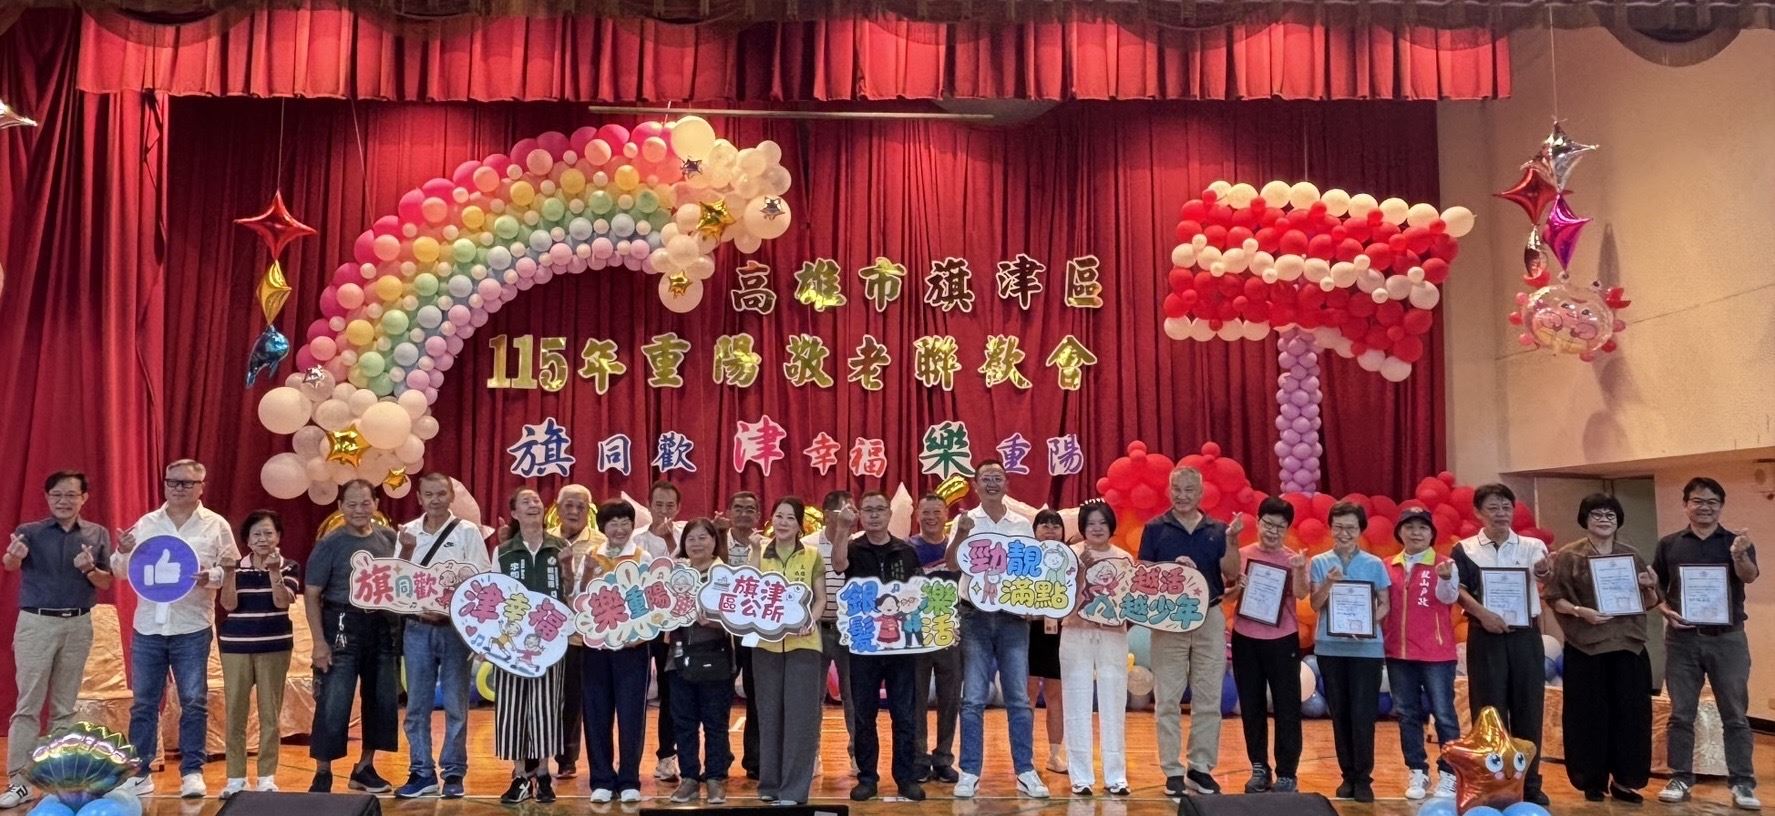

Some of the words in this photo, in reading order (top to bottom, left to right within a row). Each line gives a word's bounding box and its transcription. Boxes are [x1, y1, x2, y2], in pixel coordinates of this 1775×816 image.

[730, 255, 1104, 315] 高雄市旗津區
[486, 332, 1099, 394] 115年重陽敬老聯歡會
[508, 416, 698, 478] 旗同歡
[733, 414, 889, 478] 津幸福
[921, 420, 1086, 478] 樂重陽
[968, 539, 1043, 576] 勁靚
[354, 563, 439, 604] 旗同歡
[733, 575, 788, 605] 旗津
[1000, 579, 1069, 611] 滿點
[1131, 566, 1187, 595] 越活
[458, 580, 568, 642] 津幸福
[589, 580, 672, 633] 樂重陽
[719, 592, 785, 624] 區公所
[920, 581, 957, 647] 樂活
[1119, 594, 1205, 626] 越少年
